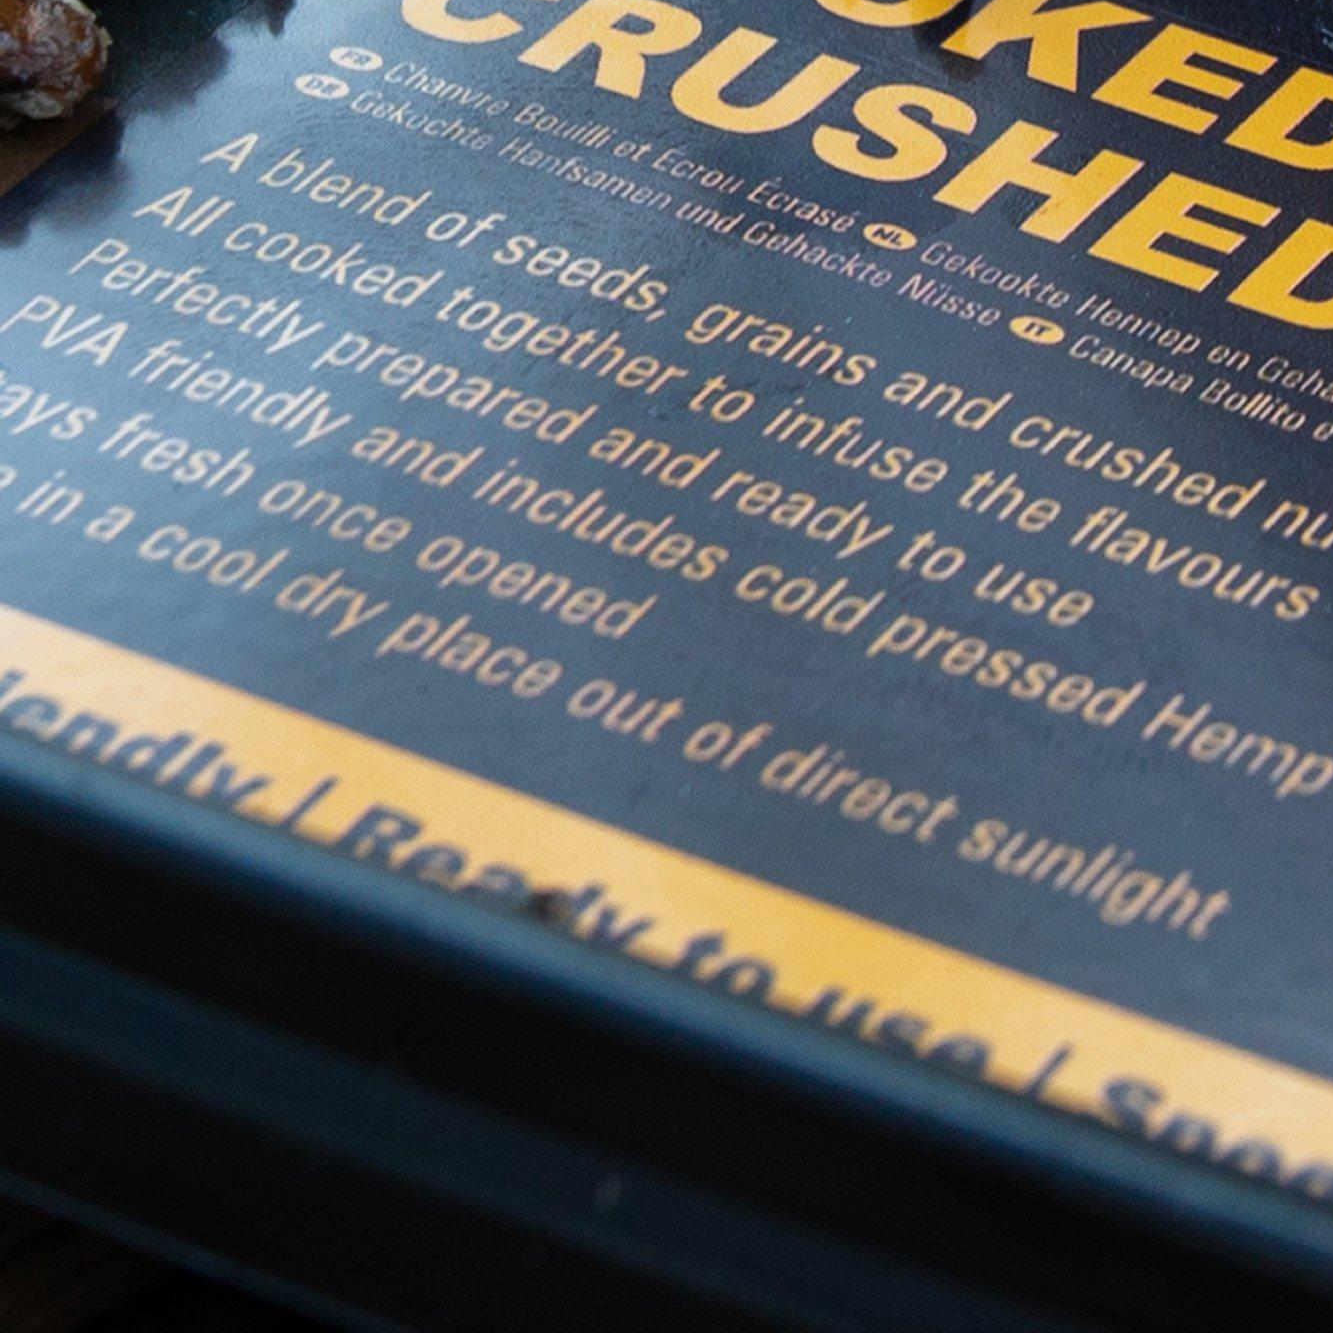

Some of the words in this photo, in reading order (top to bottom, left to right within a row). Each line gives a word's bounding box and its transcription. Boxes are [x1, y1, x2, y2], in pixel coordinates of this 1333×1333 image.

[134, 185, 233, 238] All
[222, 220, 445, 309] cooked
[435, 285, 689, 394] together
[689, 373, 756, 424] to
[763, 390, 951, 492] infuse
[956, 461, 1066, 535] the
[1070, 492, 1322, 625] flavours
[200, 132, 260, 175] A
[258, 147, 434, 227] blend
[426, 211, 507, 249] of
[492, 234, 668, 323] seeds,
[685, 303, 878, 386] grains
[883, 371, 1015, 431] and
[1009, 414, 1266, 520] crushed
[350, 90, 494, 151] Gekochte
[498, 136, 673, 210] Hanfsamen
[676, 200, 747, 234] und
[742, 220, 893, 288] Gehackte
[898, 272, 1002, 326] Nüsse
[1068, 333, 1195, 394] Canapa
[1199, 377, 1307, 432] Bollito
[383, 62, 510, 116] Chanvre
[514, 102, 618, 150] Bouilli
[613, 138, 652, 164] et
[651, 143, 744, 195] Écrou
[747, 177, 860, 233] Écrasé
[920, 240, 1071, 309] Gekookte
[1075, 294, 1202, 356] Hennep
[1207, 344, 1251, 371] en
[0, 370, 97, 440] ays
[99, 412, 255, 496] fresh
[258, 480, 412, 552] once
[415, 531, 658, 641] opened
[0, 294, 129, 367] PVA
[129, 339, 354, 449] friendly
[352, 425, 485, 491] and
[472, 459, 733, 585] includes
[735, 563, 887, 637] cold
[867, 609, 1148, 728] pressed
[68, 238, 325, 355] Perfectly
[309, 332, 597, 446] prepared
[587, 425, 728, 491] and
[710, 468, 893, 560] ready
[895, 526, 969, 582] to
[972, 563, 1097, 629] use
[16, 469, 85, 525] in
[84, 504, 136, 543] a
[137, 523, 291, 592] cool
[275, 568, 391, 637] dry
[375, 605, 563, 699] place
[567, 677, 686, 743] out
[682, 720, 771, 768] of
[759, 742, 958, 843] direct
[958, 816, 1231, 938] sunlight
